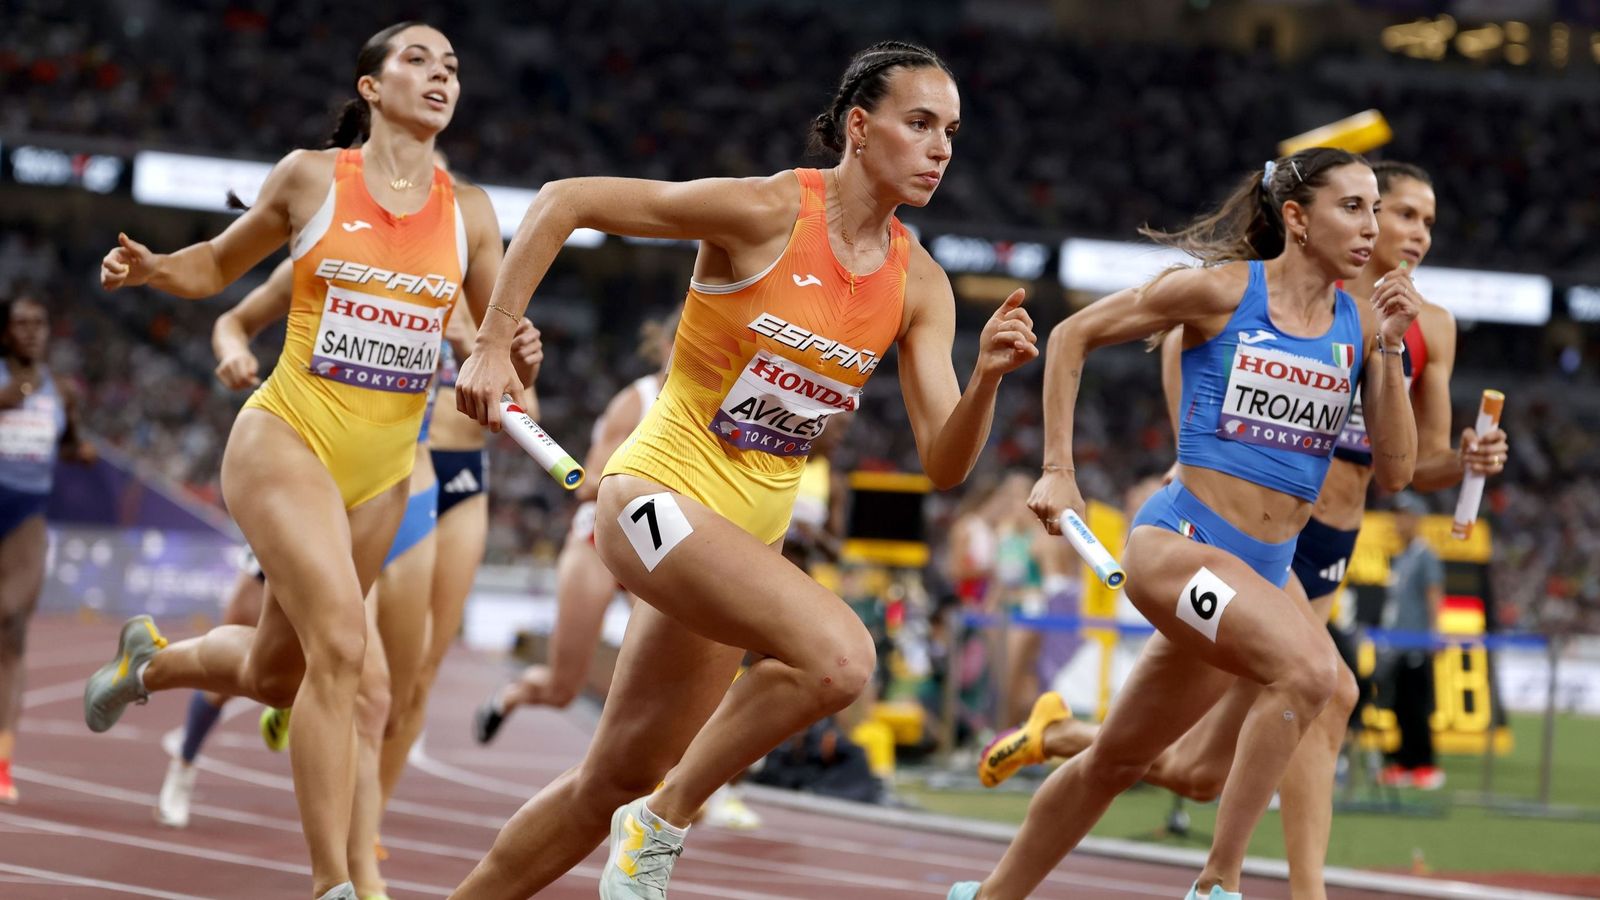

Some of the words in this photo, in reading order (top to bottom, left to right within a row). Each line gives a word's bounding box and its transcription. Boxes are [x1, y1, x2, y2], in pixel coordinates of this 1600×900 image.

[315, 258, 458, 300] ESPAÑA
[328, 297, 441, 332] HONDA
[321, 330, 437, 370] SANTIDRIÁN
[344, 368, 428, 389] TOKYO25
[749, 358, 855, 412] HONDA
[1236, 354, 1351, 394] HONDA
[1235, 384, 1345, 431] TROIANI
[630, 498, 663, 551] 7
[1189, 584, 1218, 621] 6
